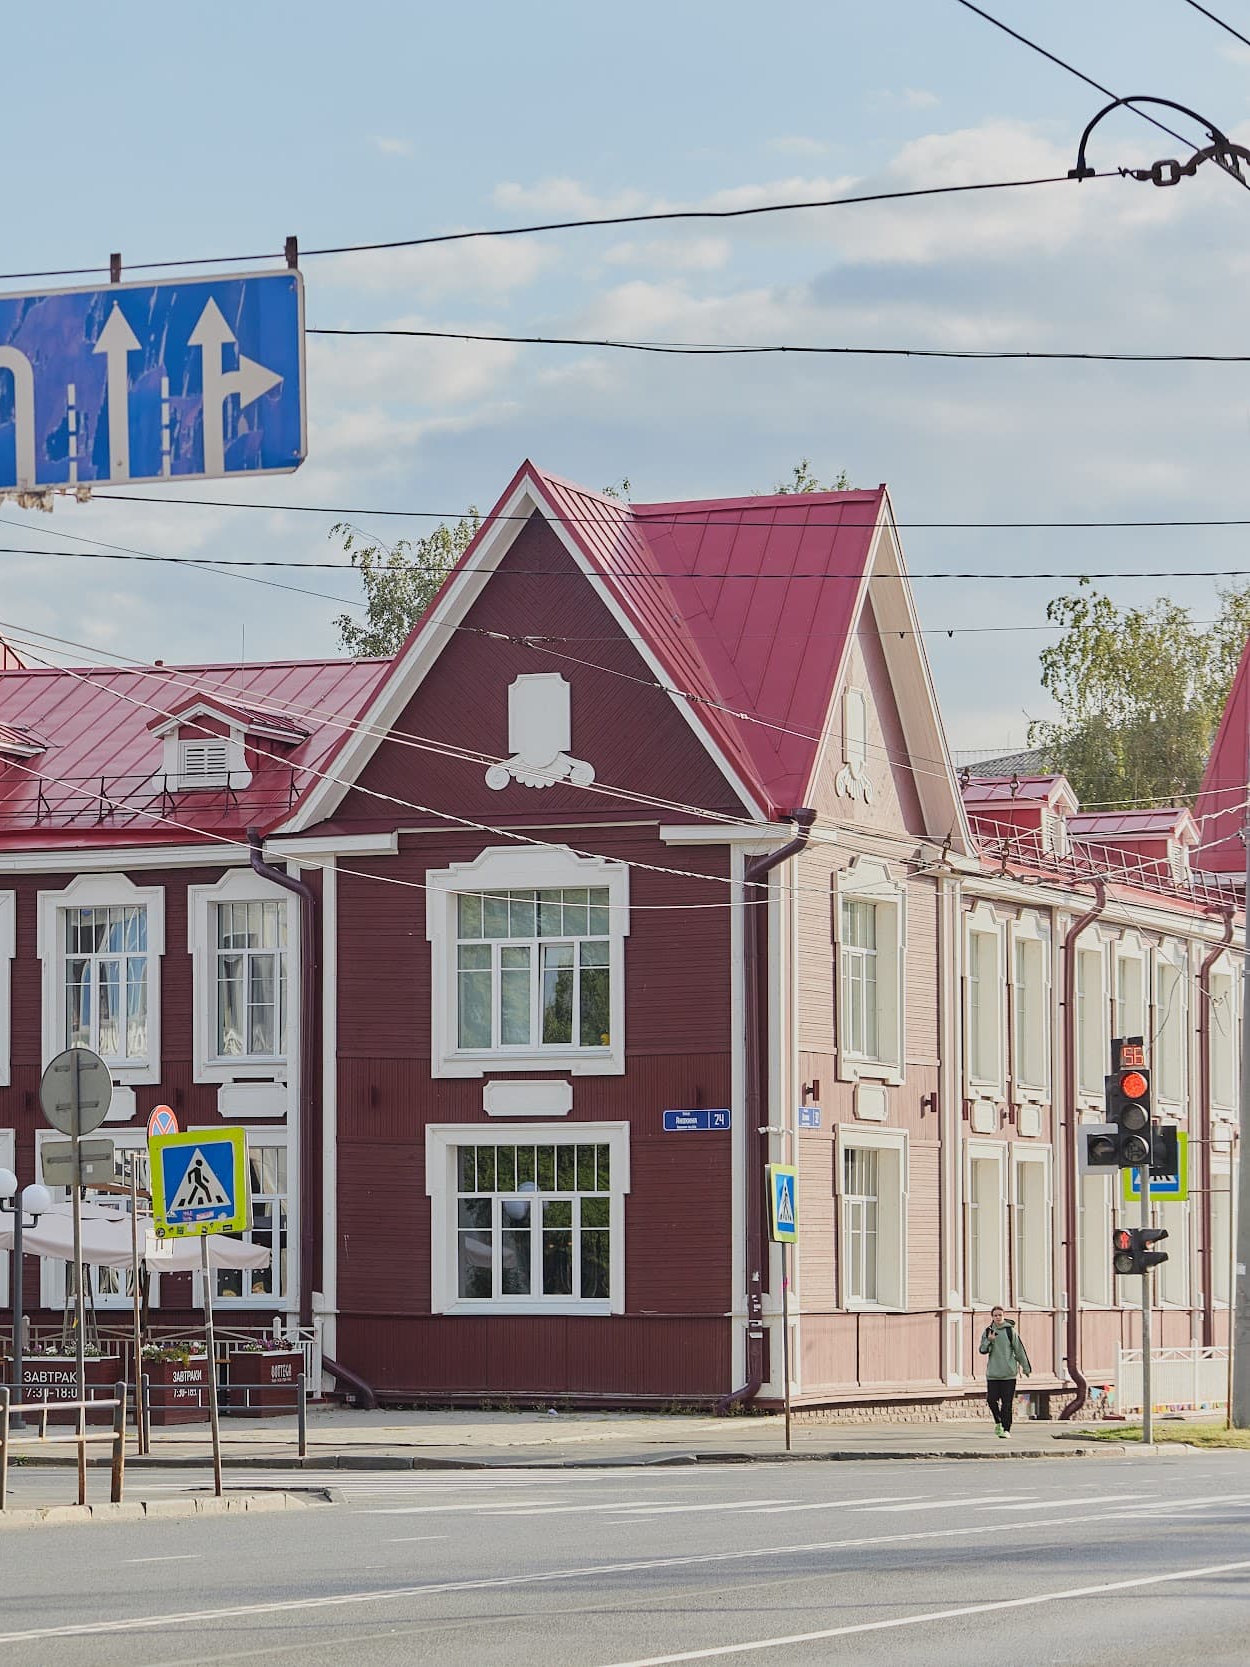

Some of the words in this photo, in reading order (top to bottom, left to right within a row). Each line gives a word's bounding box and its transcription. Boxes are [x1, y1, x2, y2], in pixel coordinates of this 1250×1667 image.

[1123, 1047, 1144, 1065] 56
[714, 1113, 725, 1126] 24
[23, 1371, 78, 1383] ЗАВТРАК
